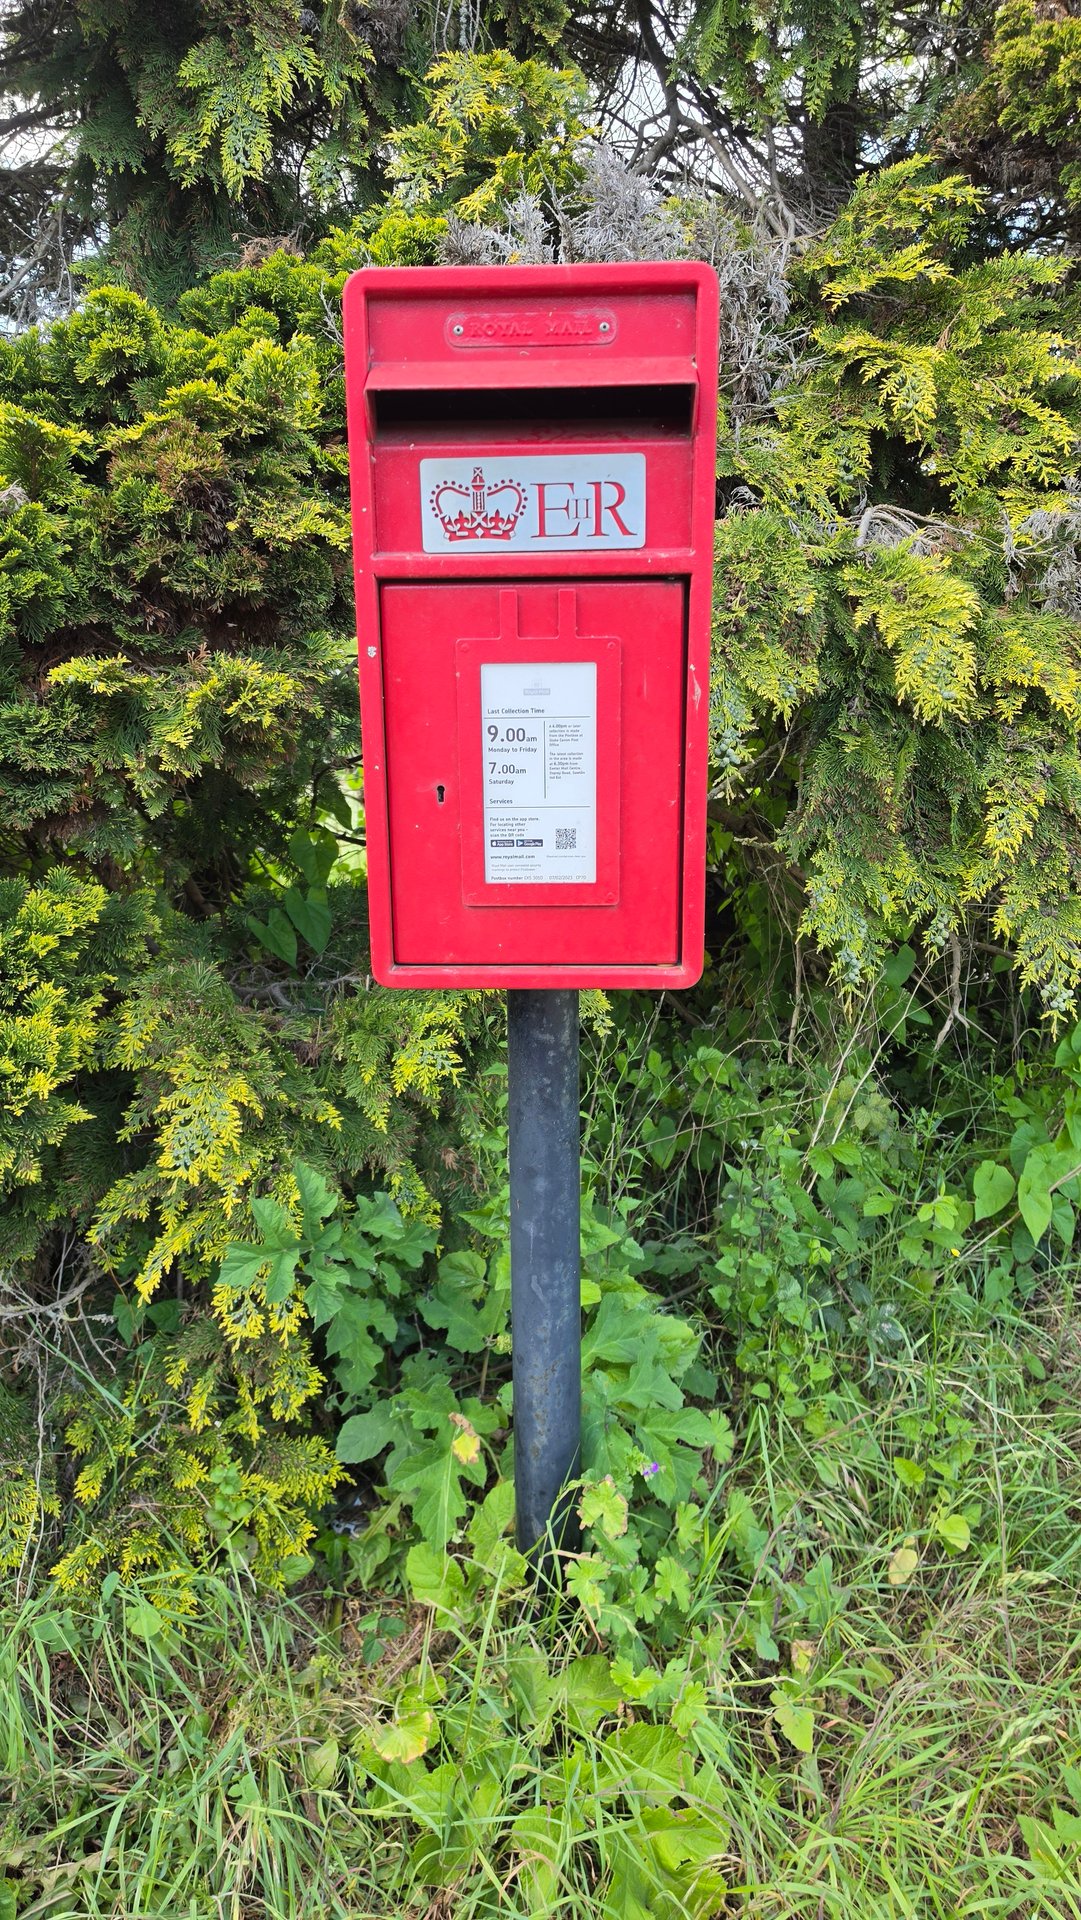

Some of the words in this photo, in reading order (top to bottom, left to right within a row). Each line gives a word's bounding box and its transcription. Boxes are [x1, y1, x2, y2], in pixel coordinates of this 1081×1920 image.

[470, 321, 533, 338] ROYAL
[545, 318, 593, 336] MAIL
[487, 724, 538, 743] 9.00am
[488, 762, 527, 774] 7.00am
